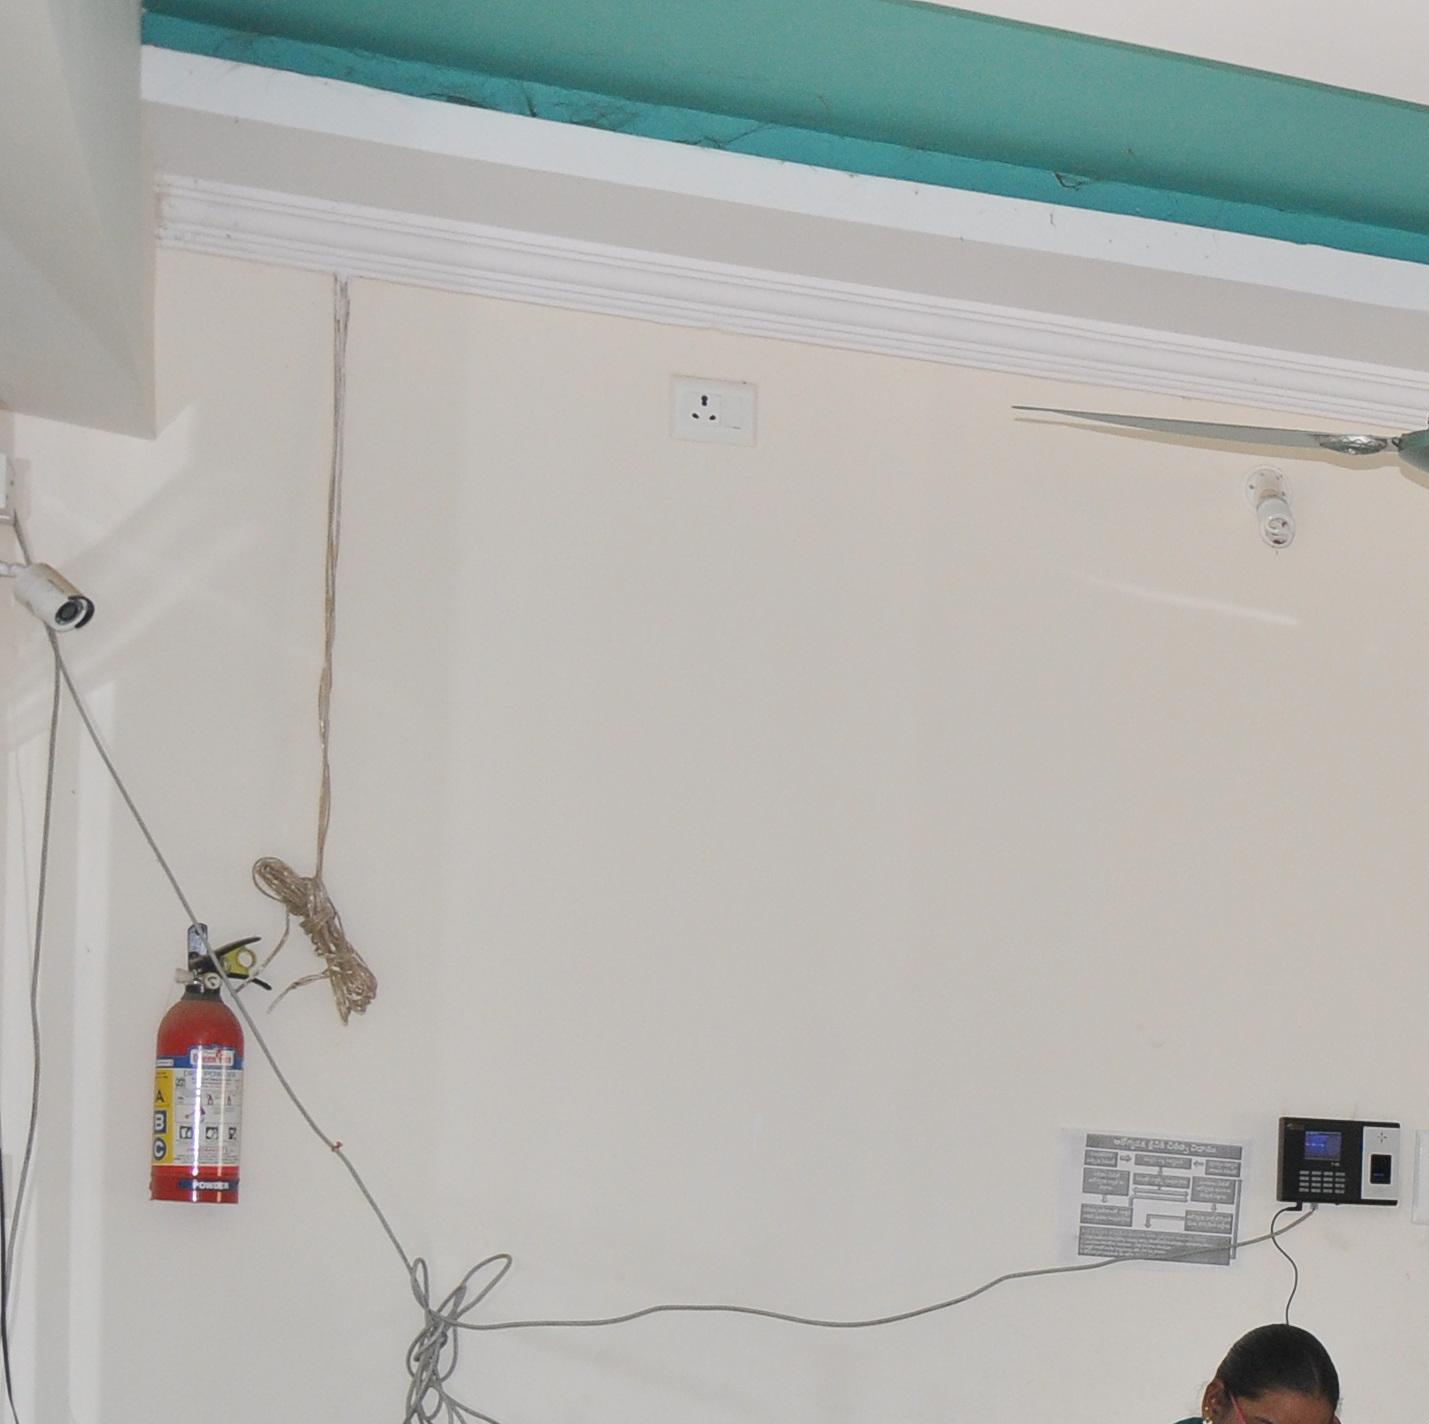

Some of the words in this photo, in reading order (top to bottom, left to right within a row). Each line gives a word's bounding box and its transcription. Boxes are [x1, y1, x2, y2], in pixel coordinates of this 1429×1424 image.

[155, 1090, 164, 1103] A
[156, 1114, 164, 1130] B
[154, 1141, 164, 1158] C
